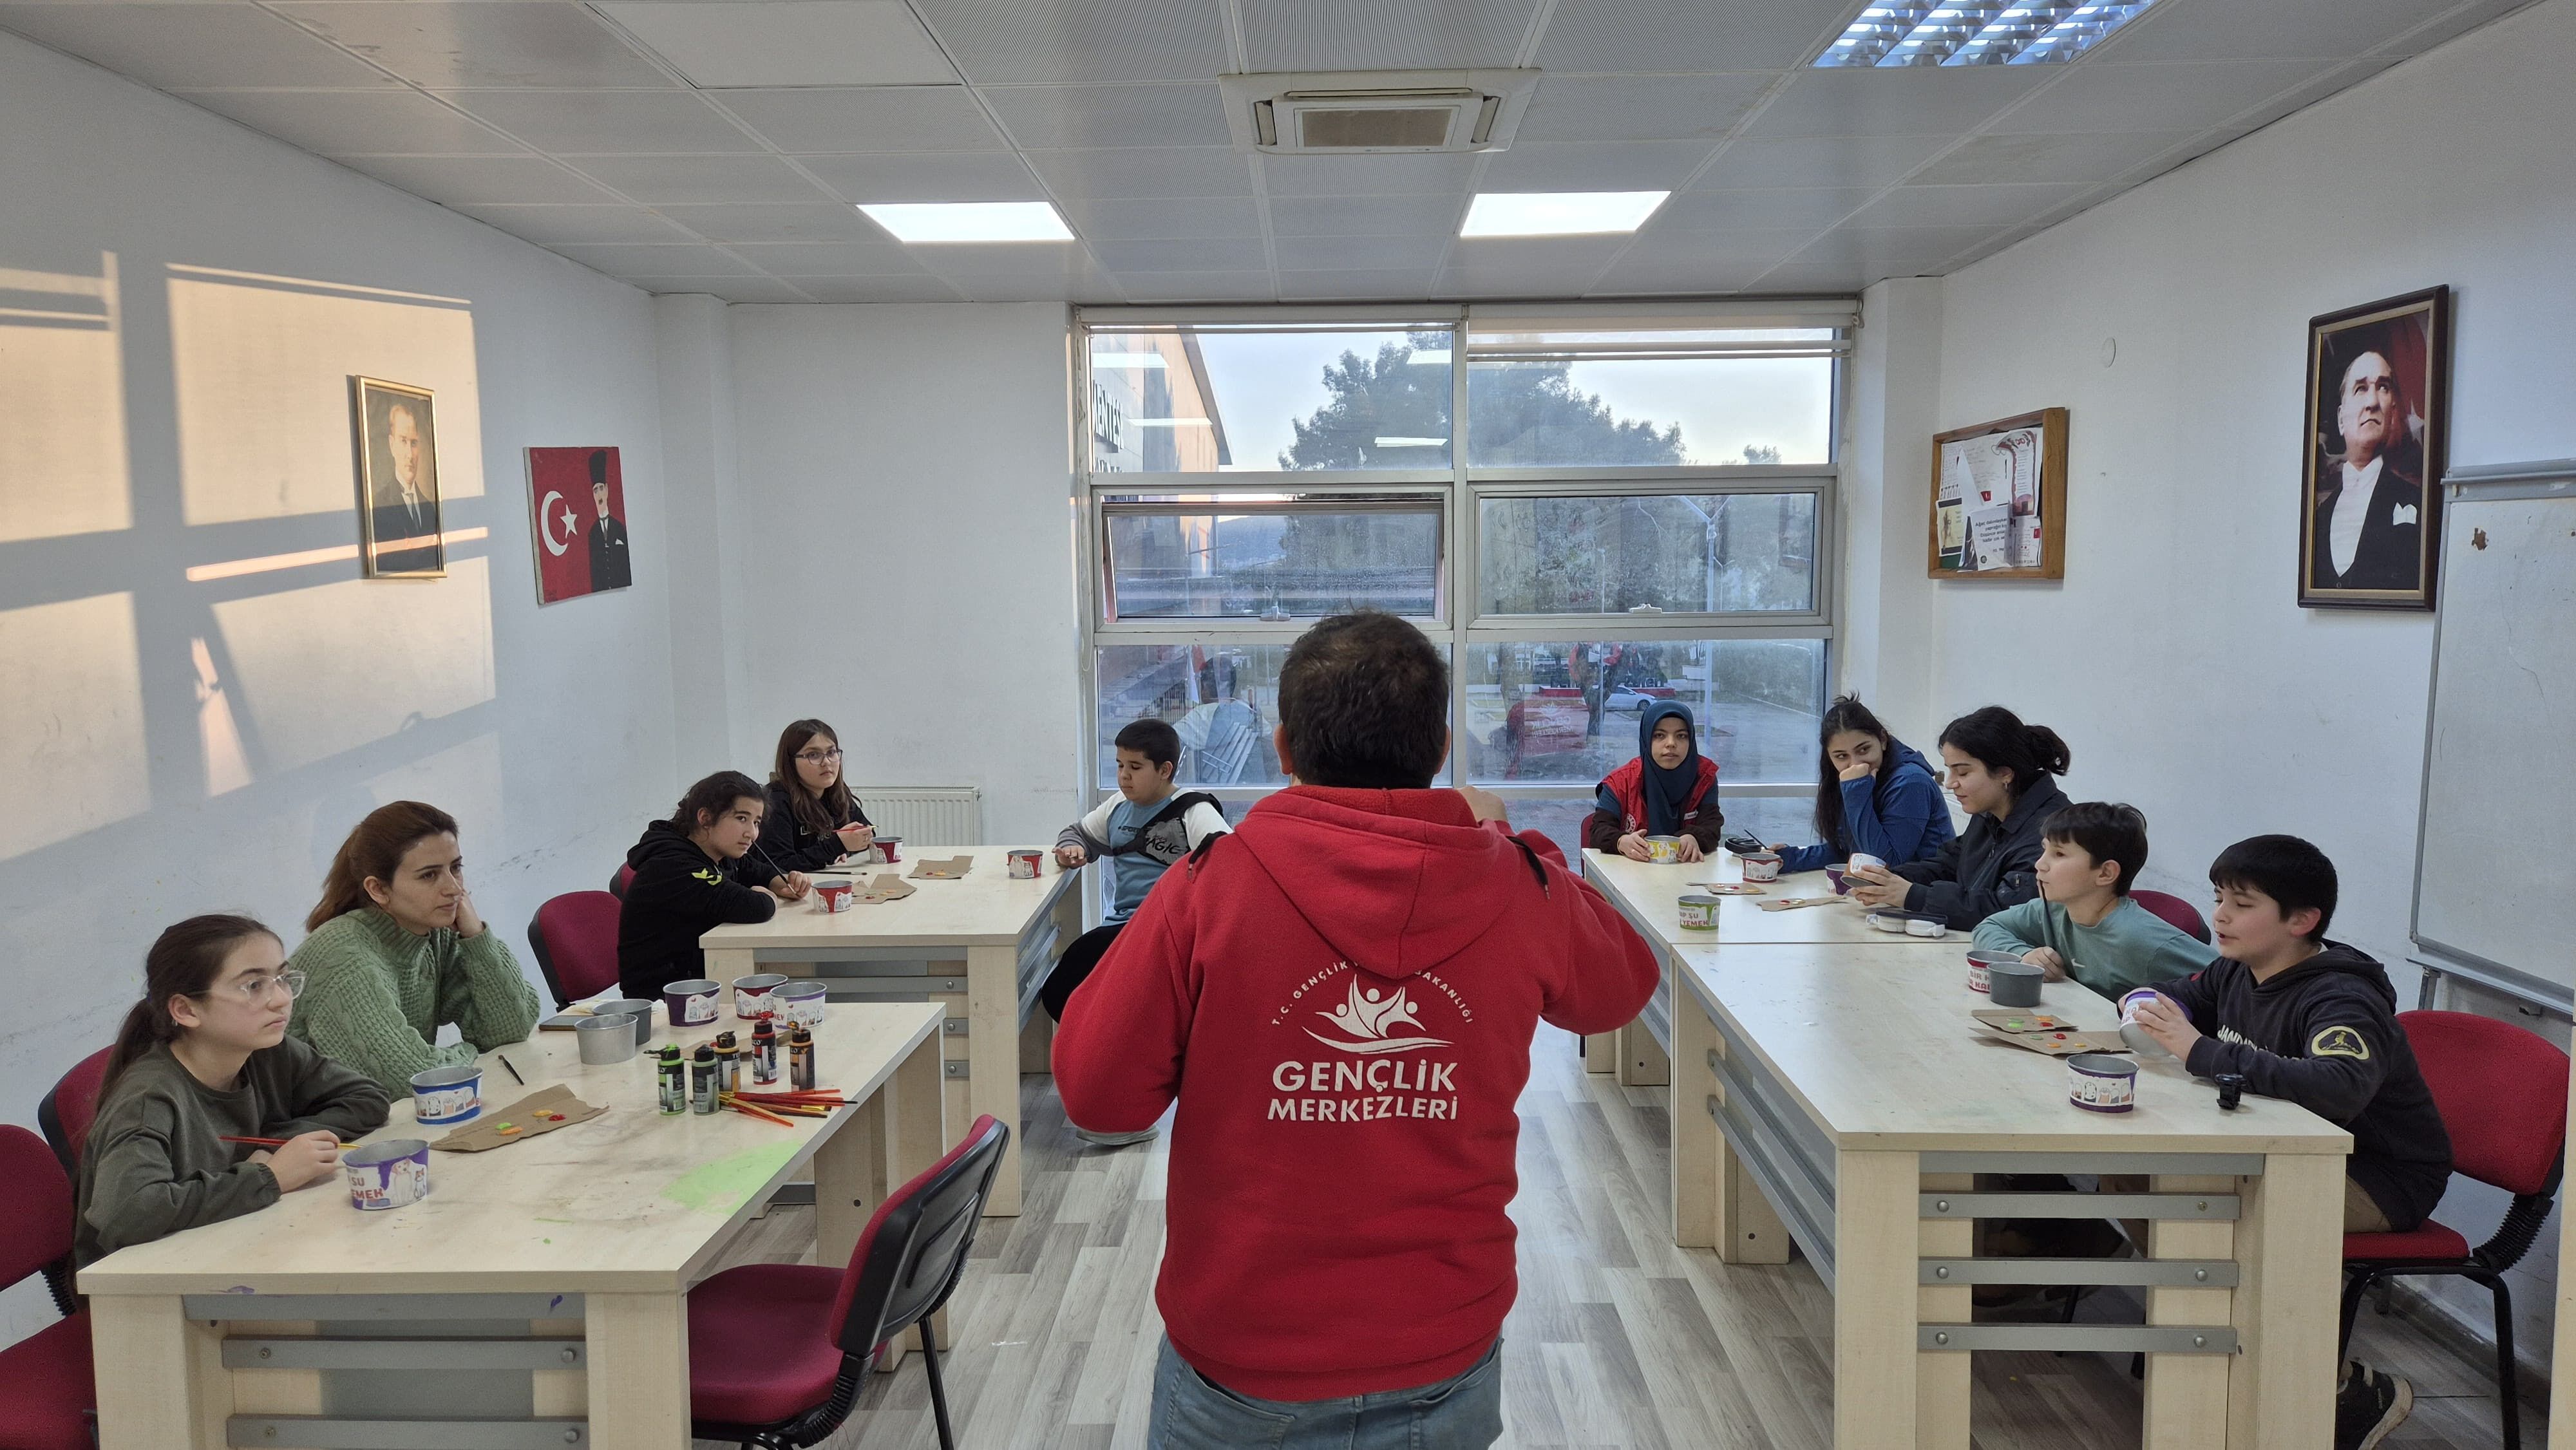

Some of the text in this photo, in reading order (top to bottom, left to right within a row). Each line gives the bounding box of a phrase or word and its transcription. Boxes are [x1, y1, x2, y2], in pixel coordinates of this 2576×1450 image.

[1272, 1004, 1293, 1026] T.C.
[1293, 961, 1348, 999] GENÇLİK
[1273, 1059, 1458, 1093] GENÇLİK
[1267, 1096, 1458, 1122] MERKEZLERİ
[350, 1188, 384, 1199] EMEK
[351, 1177, 365, 1186] SU
